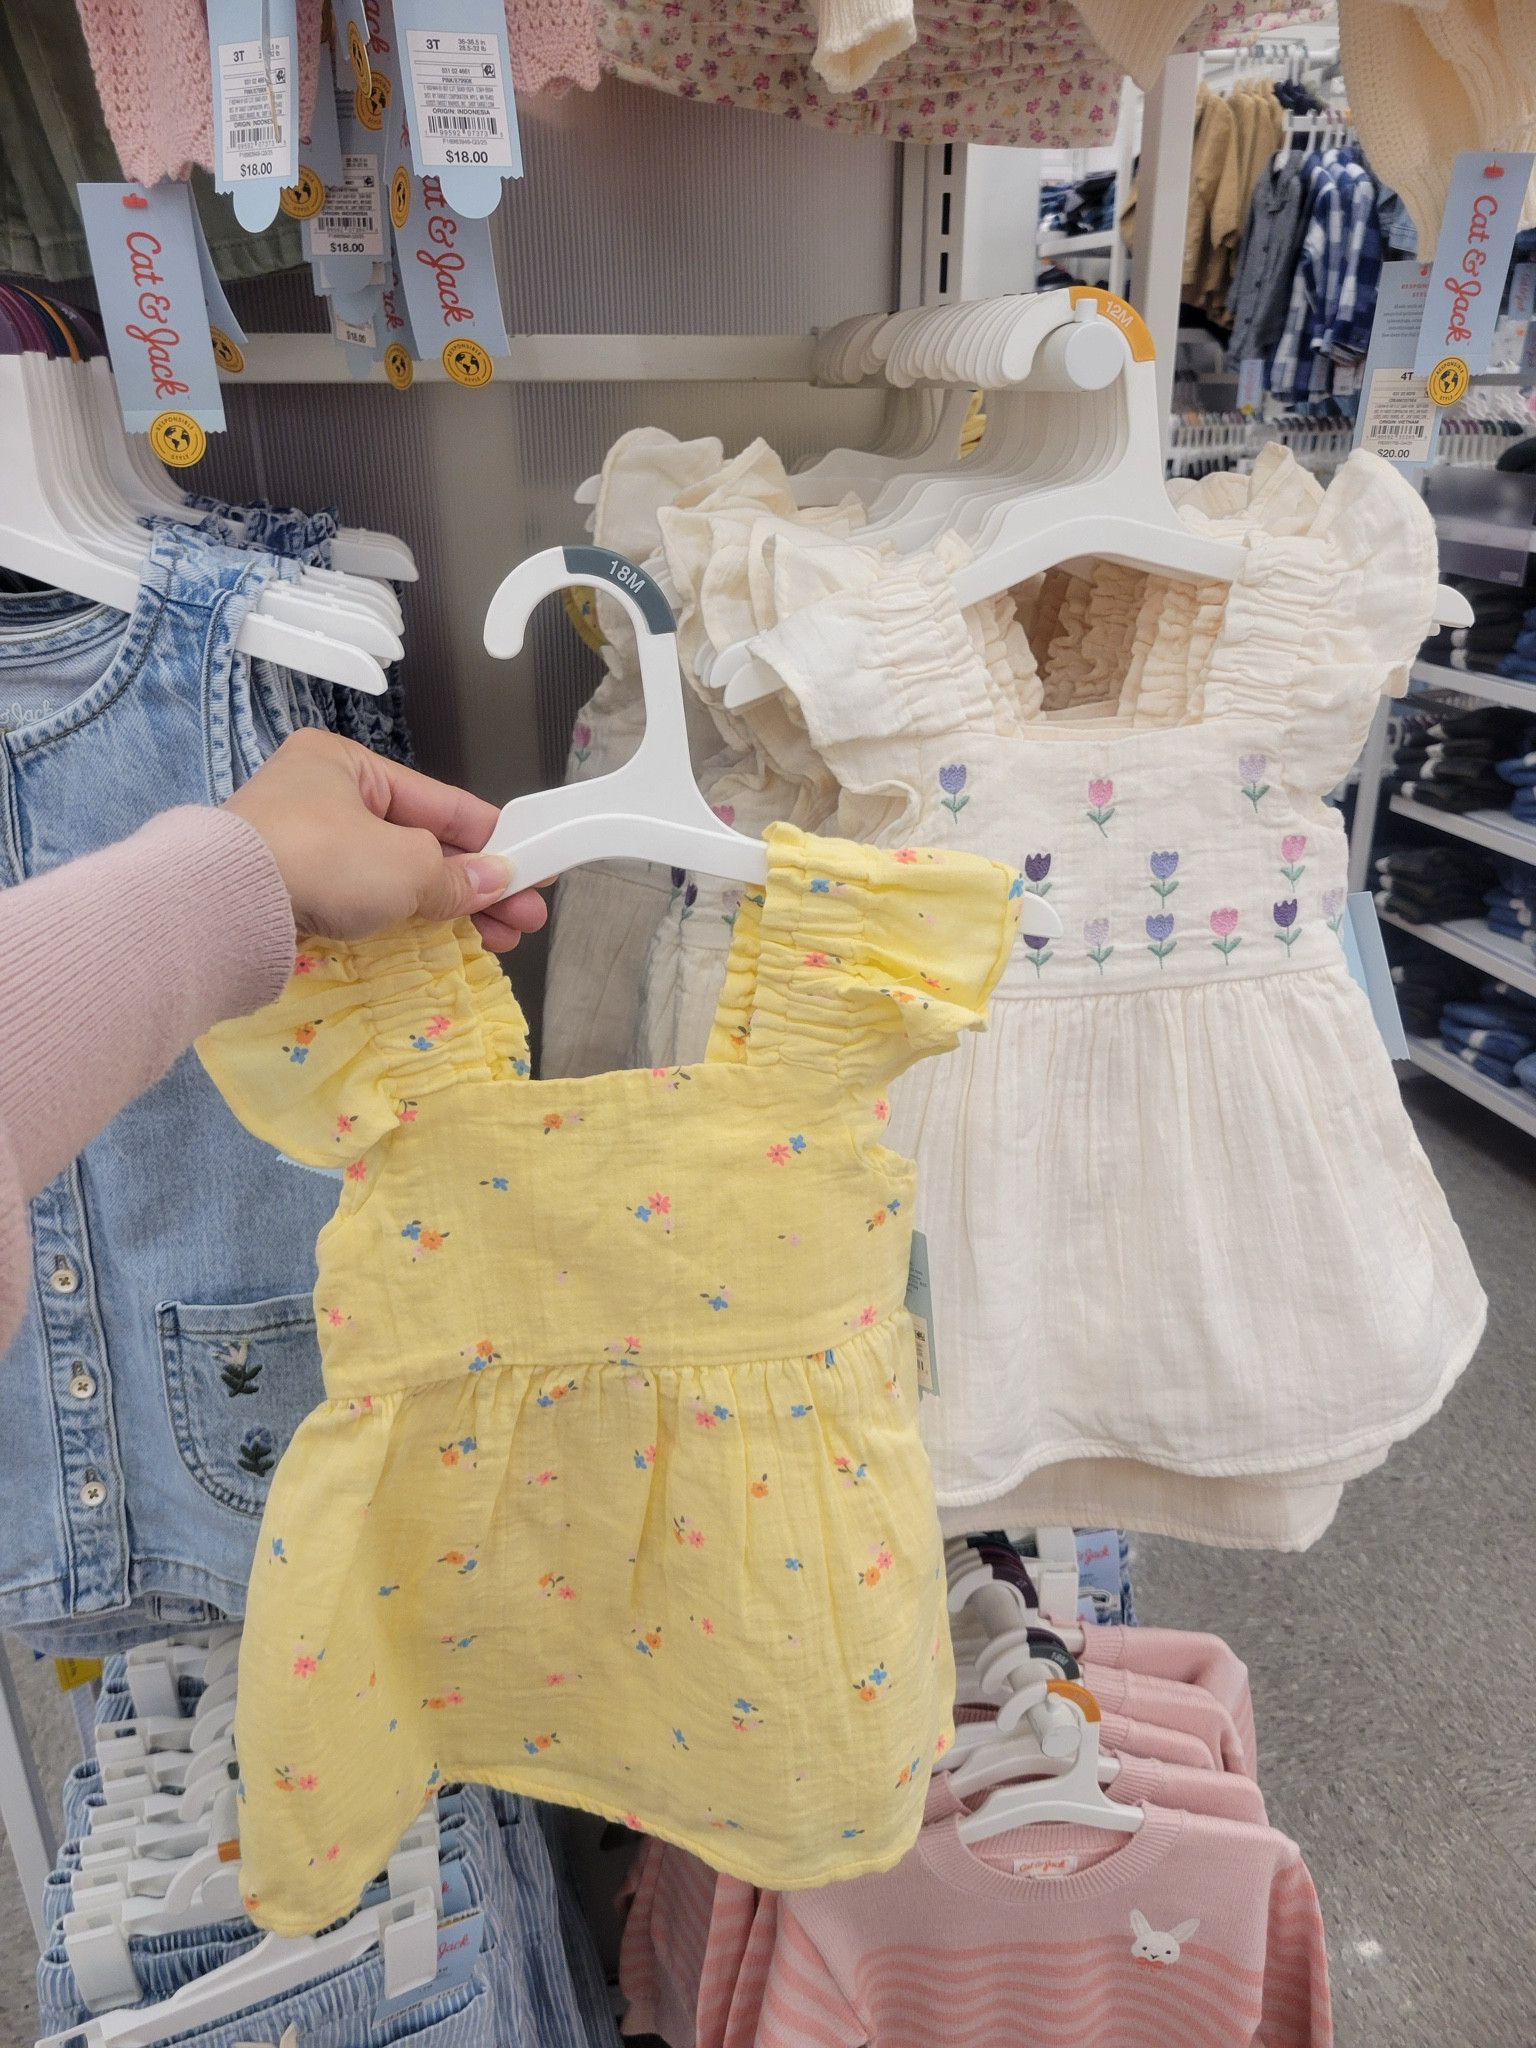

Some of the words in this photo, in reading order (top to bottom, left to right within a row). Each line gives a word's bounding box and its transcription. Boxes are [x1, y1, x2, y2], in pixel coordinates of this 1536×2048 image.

[233, 50, 245, 62] 3T
[426, 39, 440, 50] 3T
[240, 162, 273, 178] $18.00
[445, 149, 488, 164] $18.00
[422, 176, 447, 210] at
[428, 215, 457, 248] &
[1468, 194, 1498, 244] Cat
[126, 231, 164, 287] Cat
[330, 242, 365, 253] $18.00
[1462, 249, 1487, 276] &
[416, 249, 474, 327] Jack
[138, 292, 171, 324] &
[1105, 300, 1134, 328] 12M
[1444, 277, 1482, 346] Jack
[125, 324, 189, 400] Jack
[1401, 372, 1414, 381] 4T
[1377, 448, 1410, 459] $20.00
[609, 560, 646, 594] 18M
